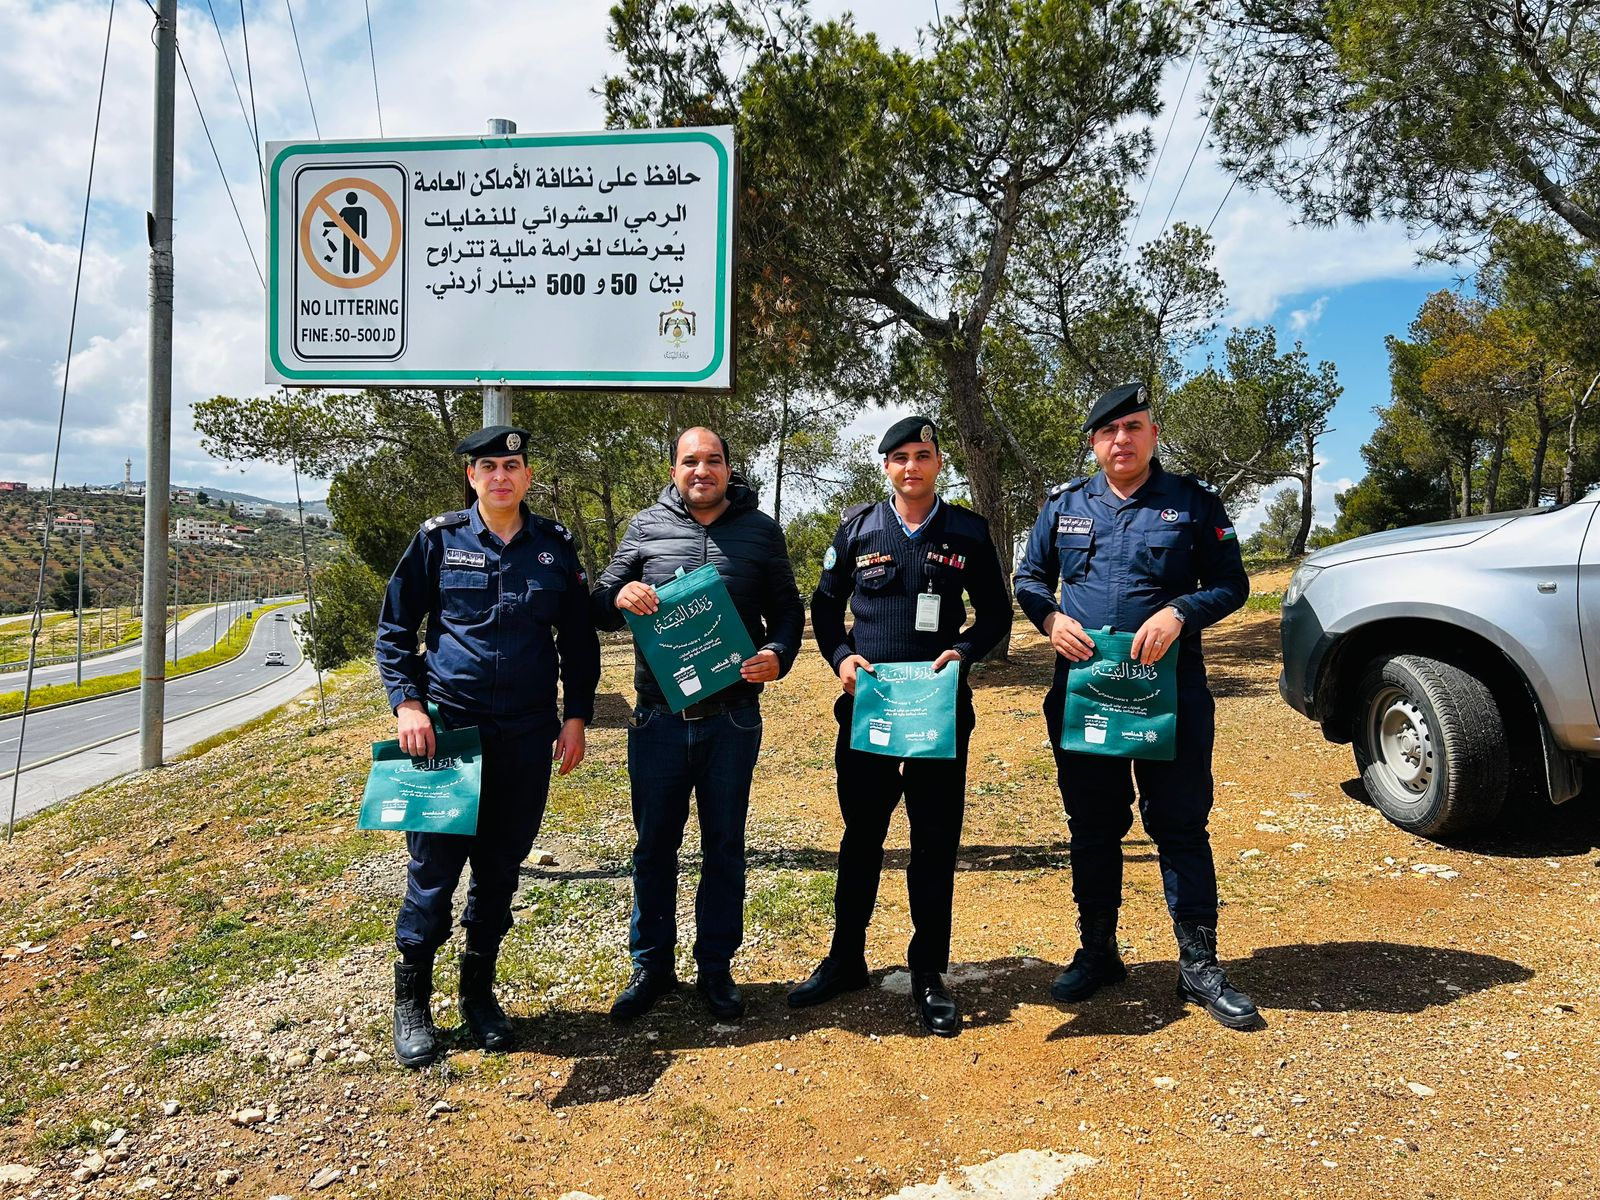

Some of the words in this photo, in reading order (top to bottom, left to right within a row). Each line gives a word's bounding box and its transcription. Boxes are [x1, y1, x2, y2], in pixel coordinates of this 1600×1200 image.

[414, 170, 466, 192] العامة
[469, 163, 531, 196] الأماكن
[535, 165, 594, 189] نظافة
[598, 164, 638, 194] على
[643, 163, 701, 186] حافظ
[424, 206, 517, 233] للنفايات
[522, 204, 618, 235] العشوائي
[624, 203, 687, 233] الرمي
[426, 240, 485, 266] تتراوح
[489, 239, 537, 264] مالية
[542, 237, 602, 262] لغرامة
[425, 267, 483, 300] أردني.
[485, 270, 537, 295] دينار
[546, 273, 586, 295] 500
[593, 278, 605, 295] و
[611, 273, 637, 295] 50
[649, 271, 685, 294] بين
[300, 299, 321, 316] NO
[325, 299, 399, 316] LITTERING
